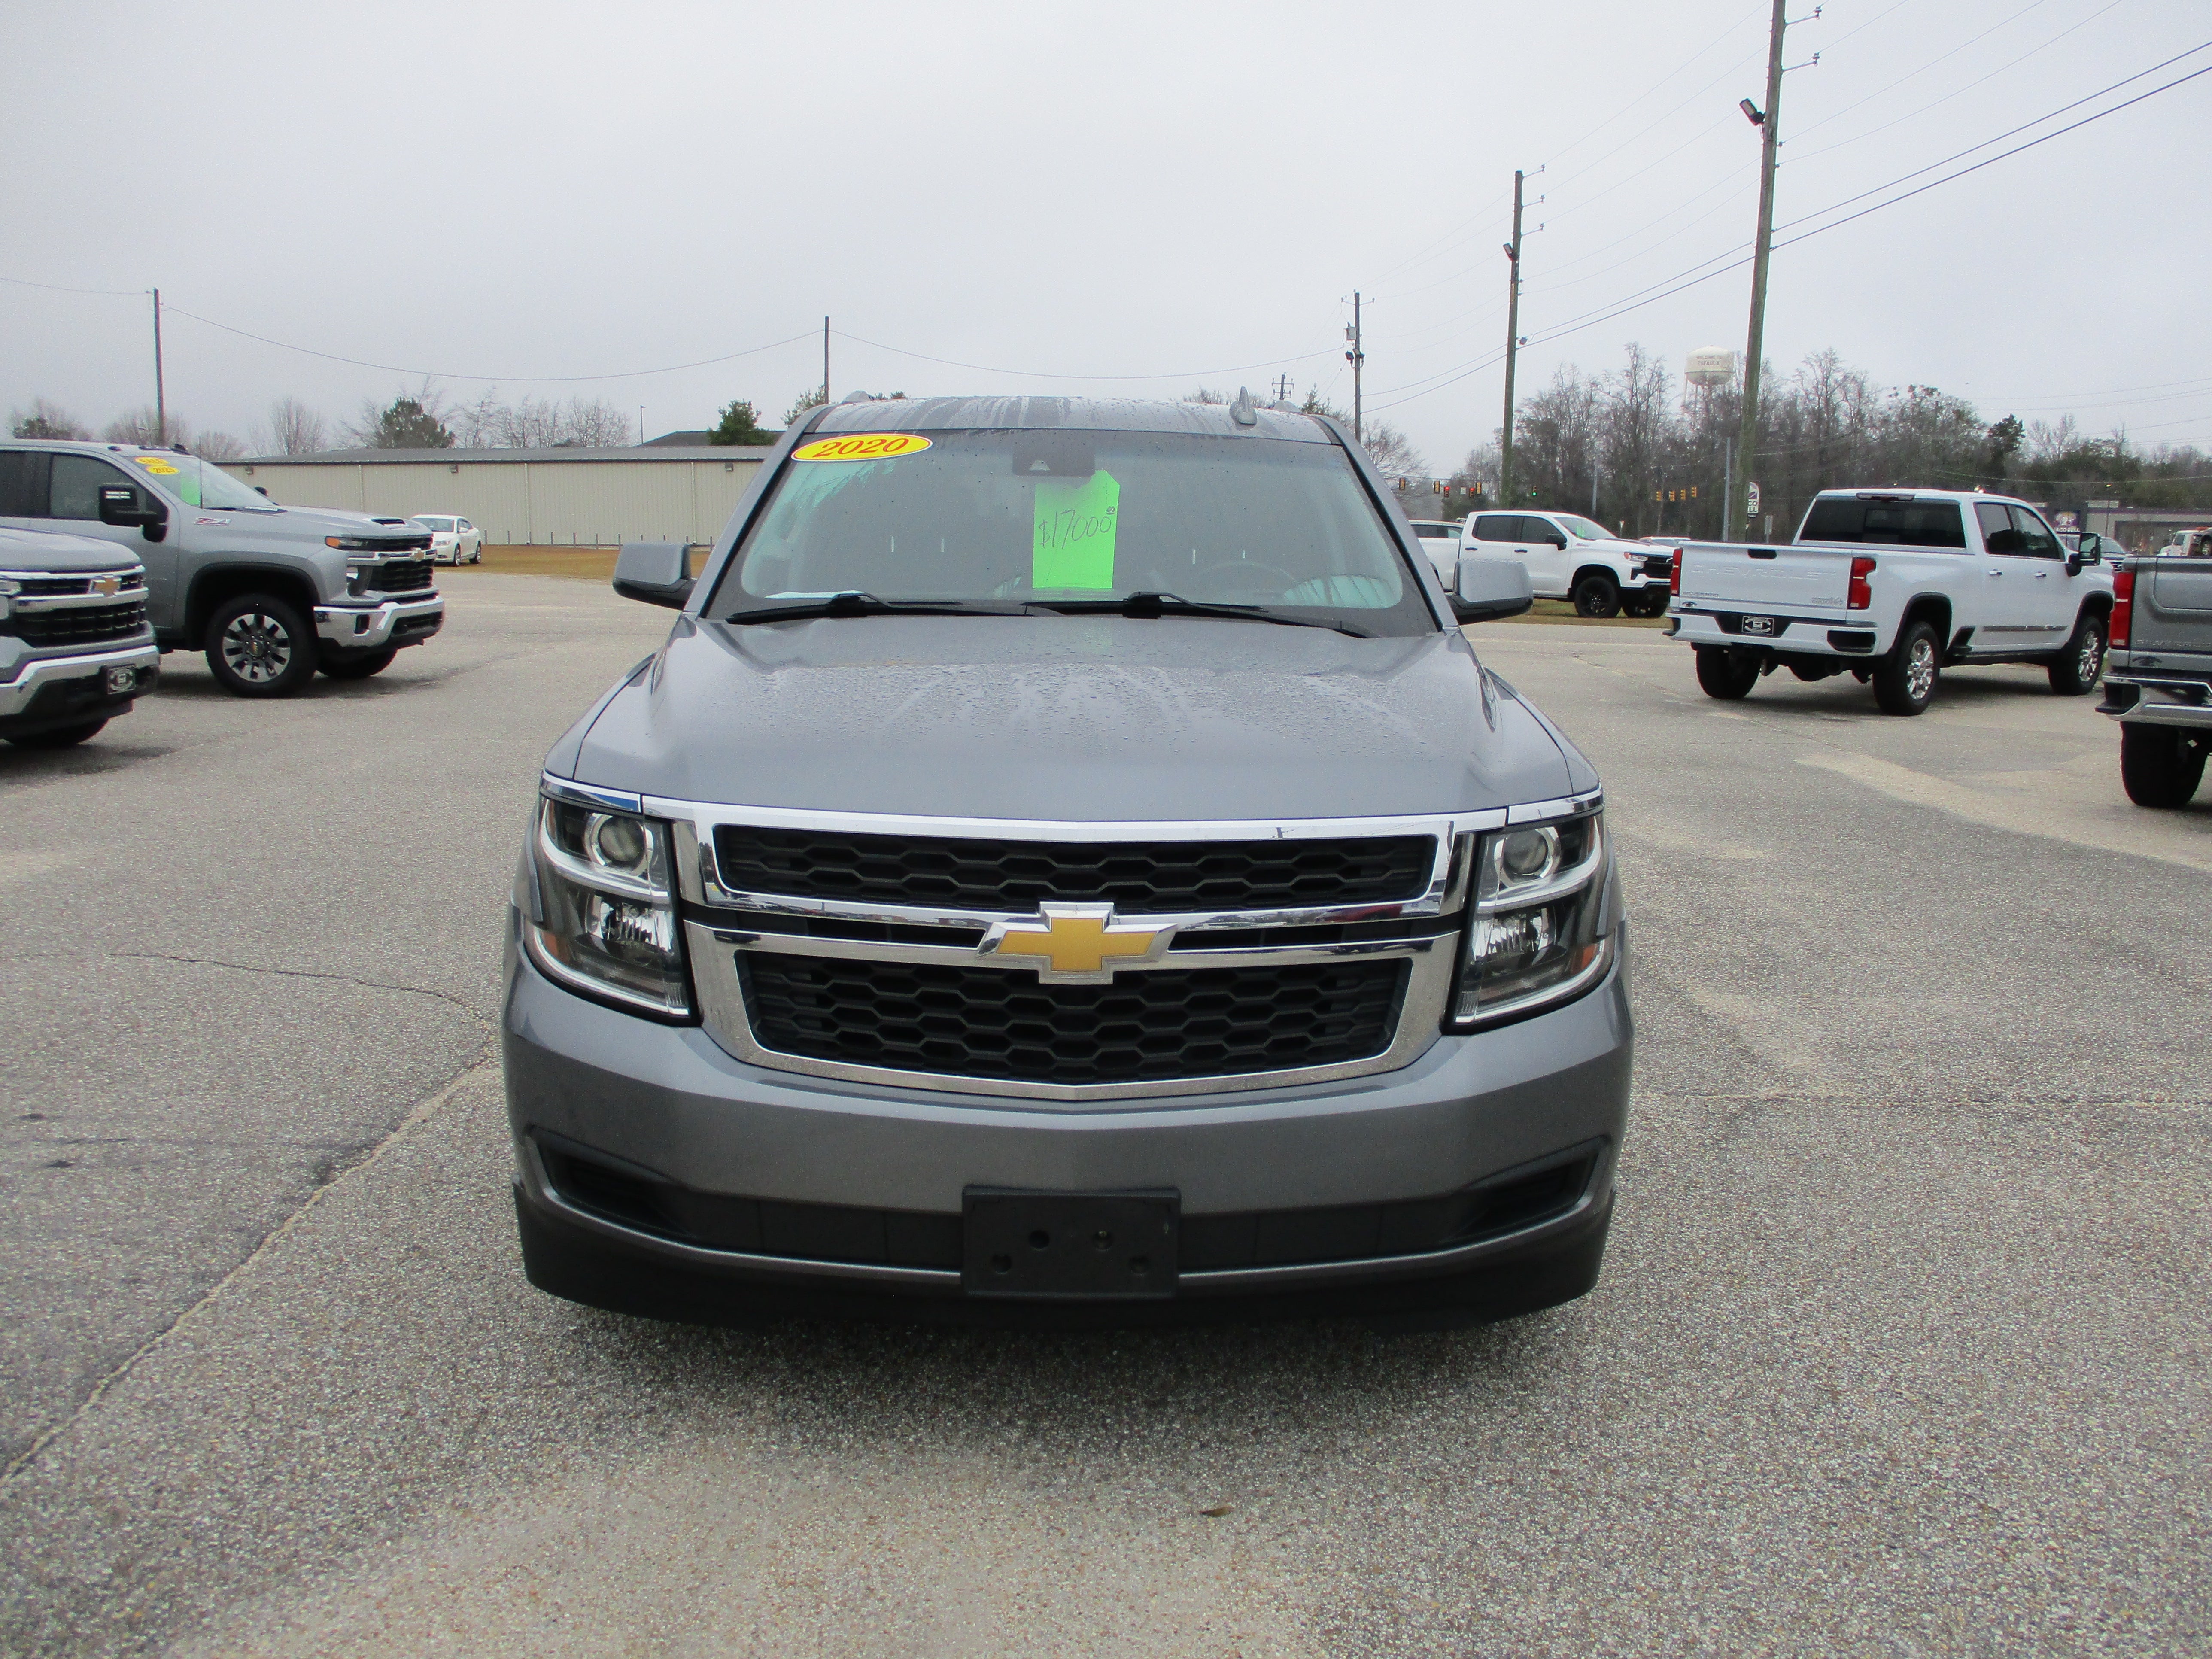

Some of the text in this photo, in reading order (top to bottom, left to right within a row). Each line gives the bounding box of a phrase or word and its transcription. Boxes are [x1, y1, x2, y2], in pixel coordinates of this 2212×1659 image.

[812, 438, 909, 458] 2020
[1038, 509, 1112, 550] $17000
[1691, 565, 1837, 581] CHEVROLET
